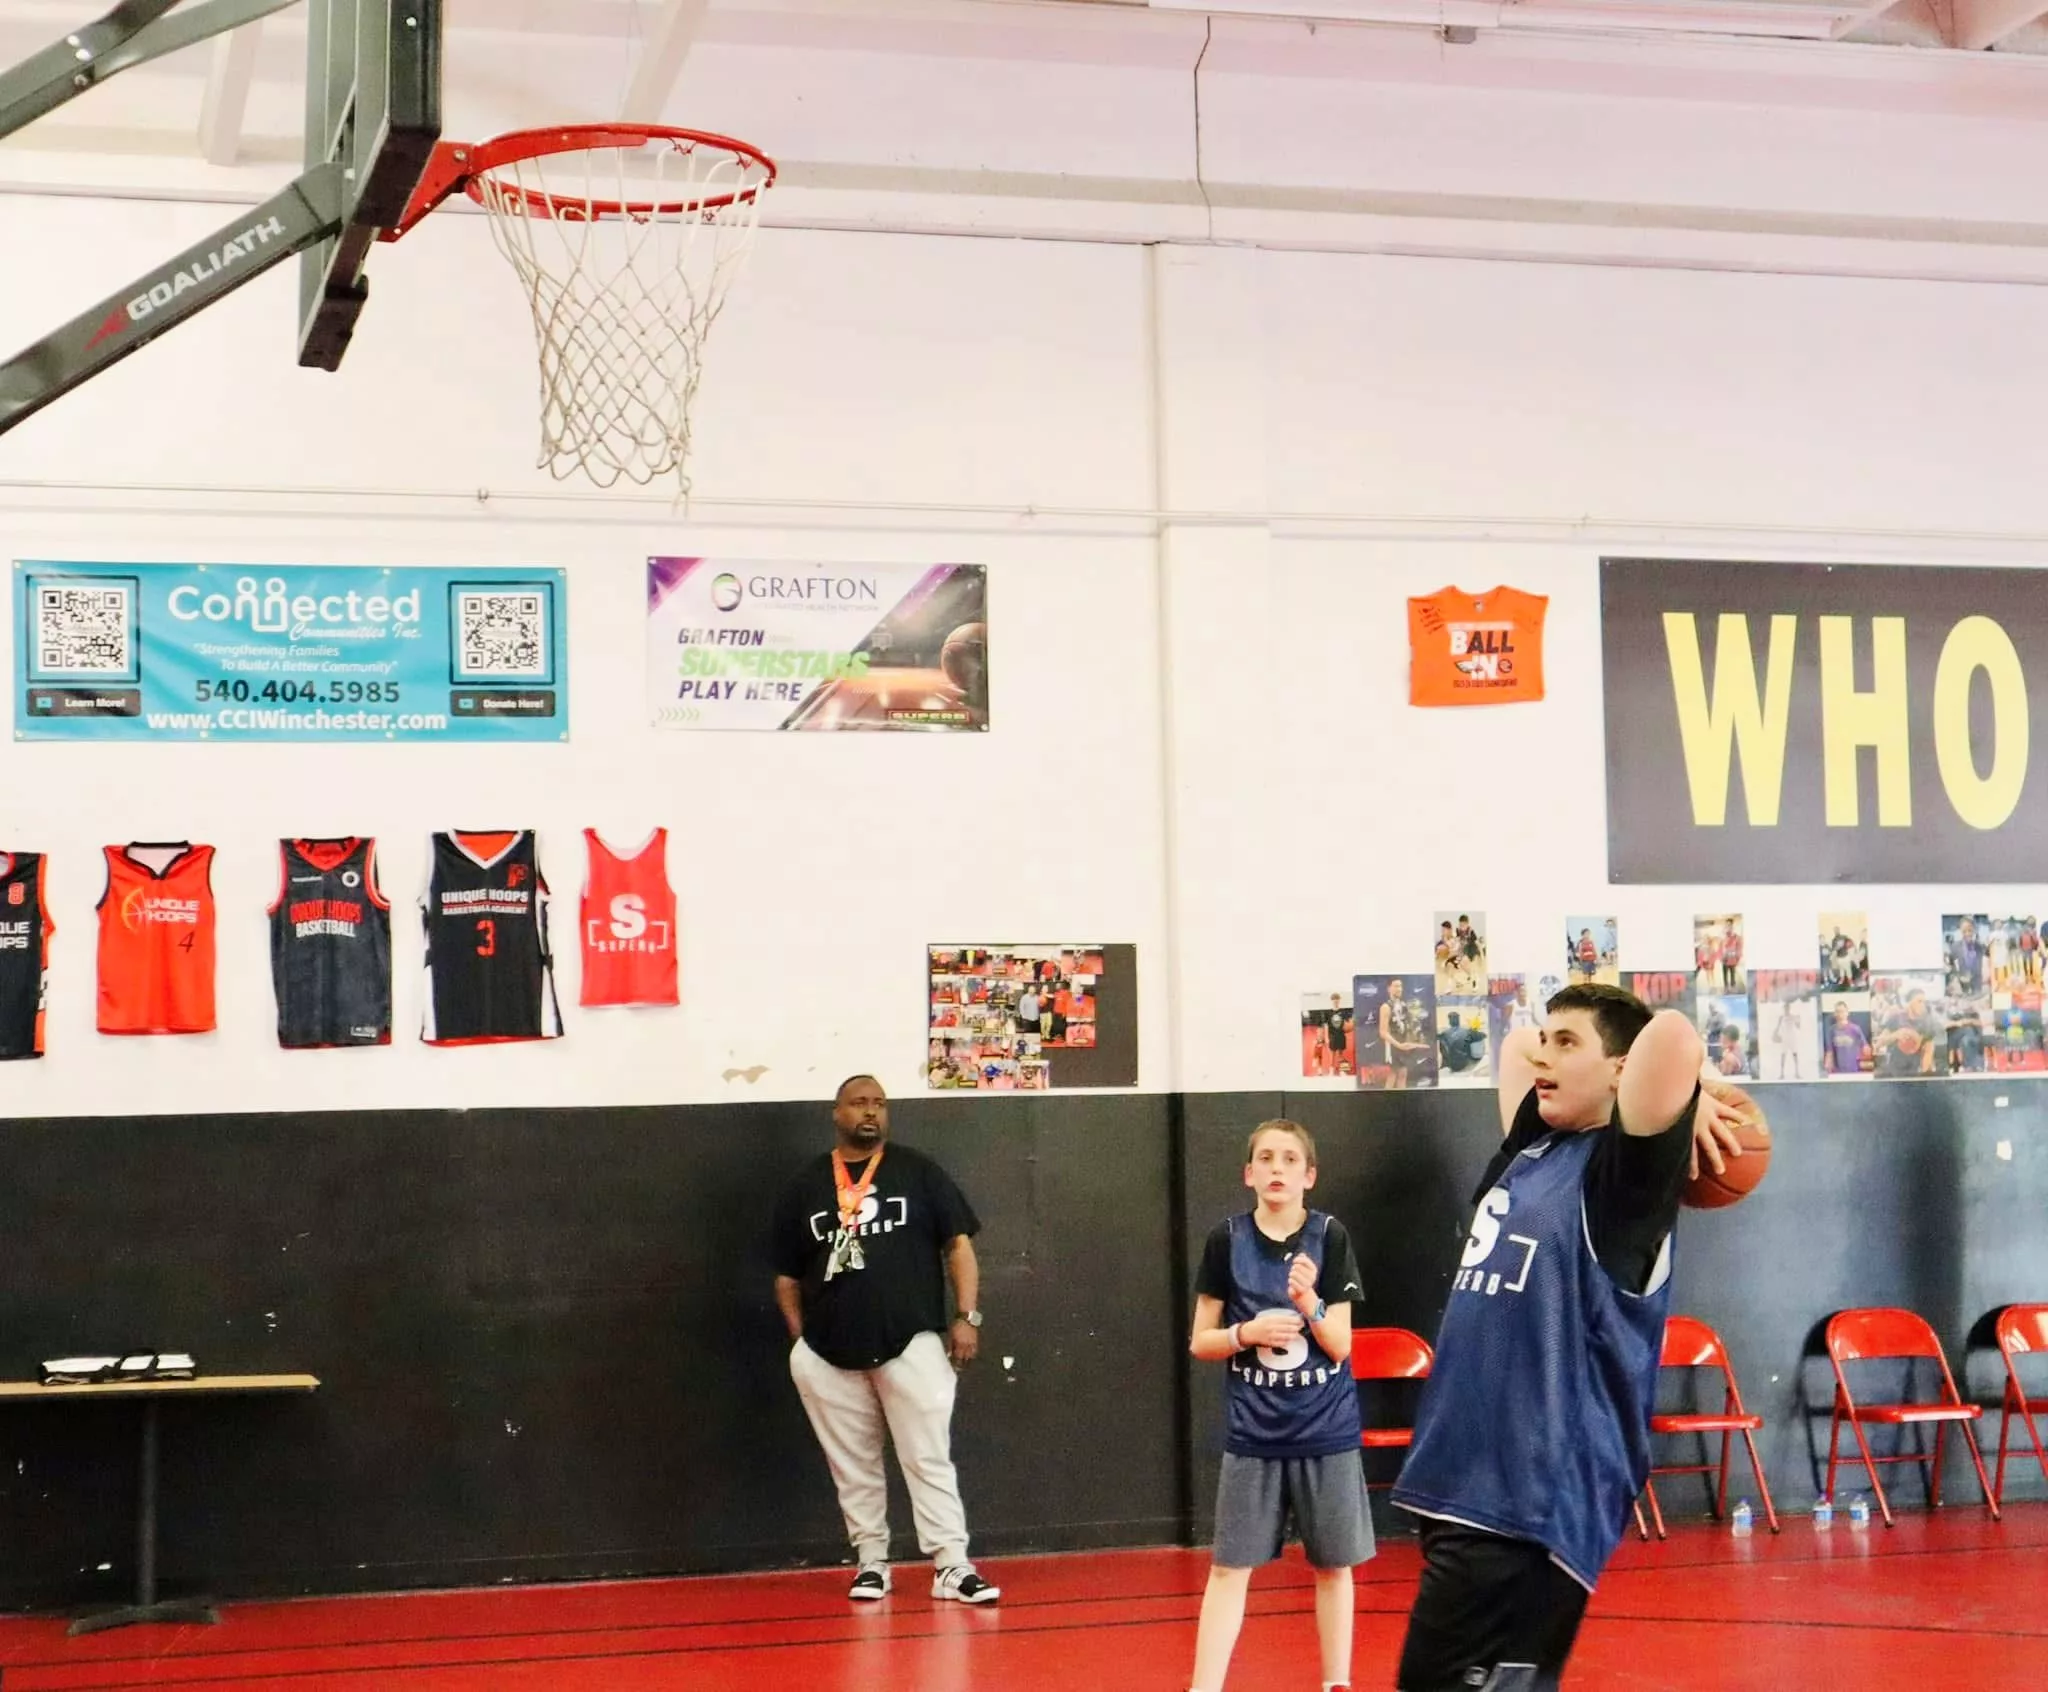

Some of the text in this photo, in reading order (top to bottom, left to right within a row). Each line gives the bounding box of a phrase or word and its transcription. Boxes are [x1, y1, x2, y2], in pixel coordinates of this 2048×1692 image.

[126, 215, 283, 321] GOALIATH
[748, 576, 878, 600] GRAFTON
[167, 576, 420, 632] Connected
[290, 622, 422, 641] Communities Inc.
[677, 628, 765, 646] GRAFTON
[1449, 629, 1515, 656] BALL
[289, 644, 340, 658] Families
[221, 659, 235, 671] To
[237, 660, 270, 672] Build
[271, 660, 281, 672] A
[282, 661, 319, 673] Better
[194, 678, 401, 703] 540.404.5985
[677, 680, 804, 701] PLAY HERE
[146, 707, 447, 731] www.CCIWinchester.com
[1662, 612, 2030, 830] WHO
[143, 897, 201, 911] UNIQUE
[440, 888, 529, 904] UNIQUE HOOPS
[146, 910, 198, 923] HOOPS
[295, 918, 357, 938] BASKETBALL
[609, 893, 647, 940] S
[177, 930, 196, 954] 4
[475, 919, 496, 957] 3
[826, 1219, 894, 1244] SPERB
[1461, 1186, 1511, 1268] S
[1243, 1367, 1328, 1388] SUPERB
